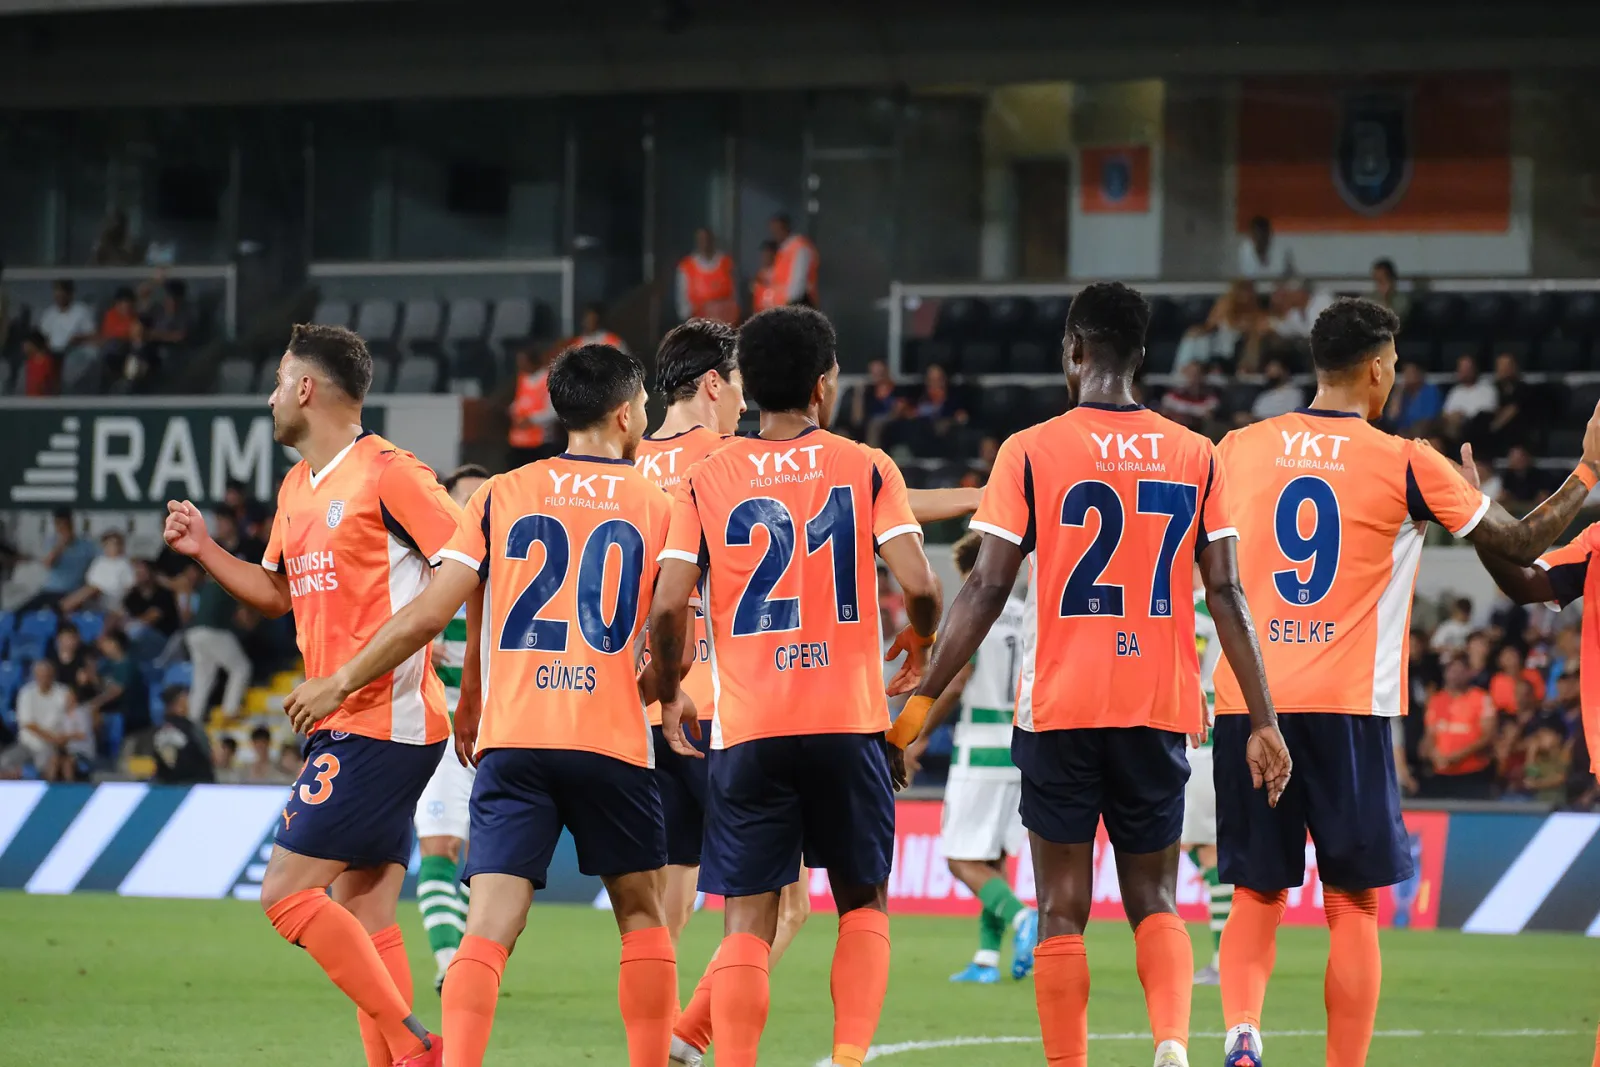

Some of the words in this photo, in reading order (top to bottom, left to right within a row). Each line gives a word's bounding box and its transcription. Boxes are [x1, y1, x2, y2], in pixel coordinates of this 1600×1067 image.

[92, 415, 305, 501] RAM
[748, 444, 824, 476] YKT
[1091, 432, 1165, 460] YKT
[1281, 430, 1351, 460] YKT
[548, 468, 626, 499] YKT
[1059, 478, 1199, 618] 27
[1272, 474, 1342, 607] 9
[725, 485, 860, 637] 21
[289, 571, 339, 598] AINES
[497, 512, 646, 656] 20
[1116, 631, 1141, 657] BA
[1269, 618, 1336, 644] SELKE
[774, 641, 830, 672] OPERI
[535, 660, 597, 694] GÜNEŞ
[288, 752, 341, 806] 3
